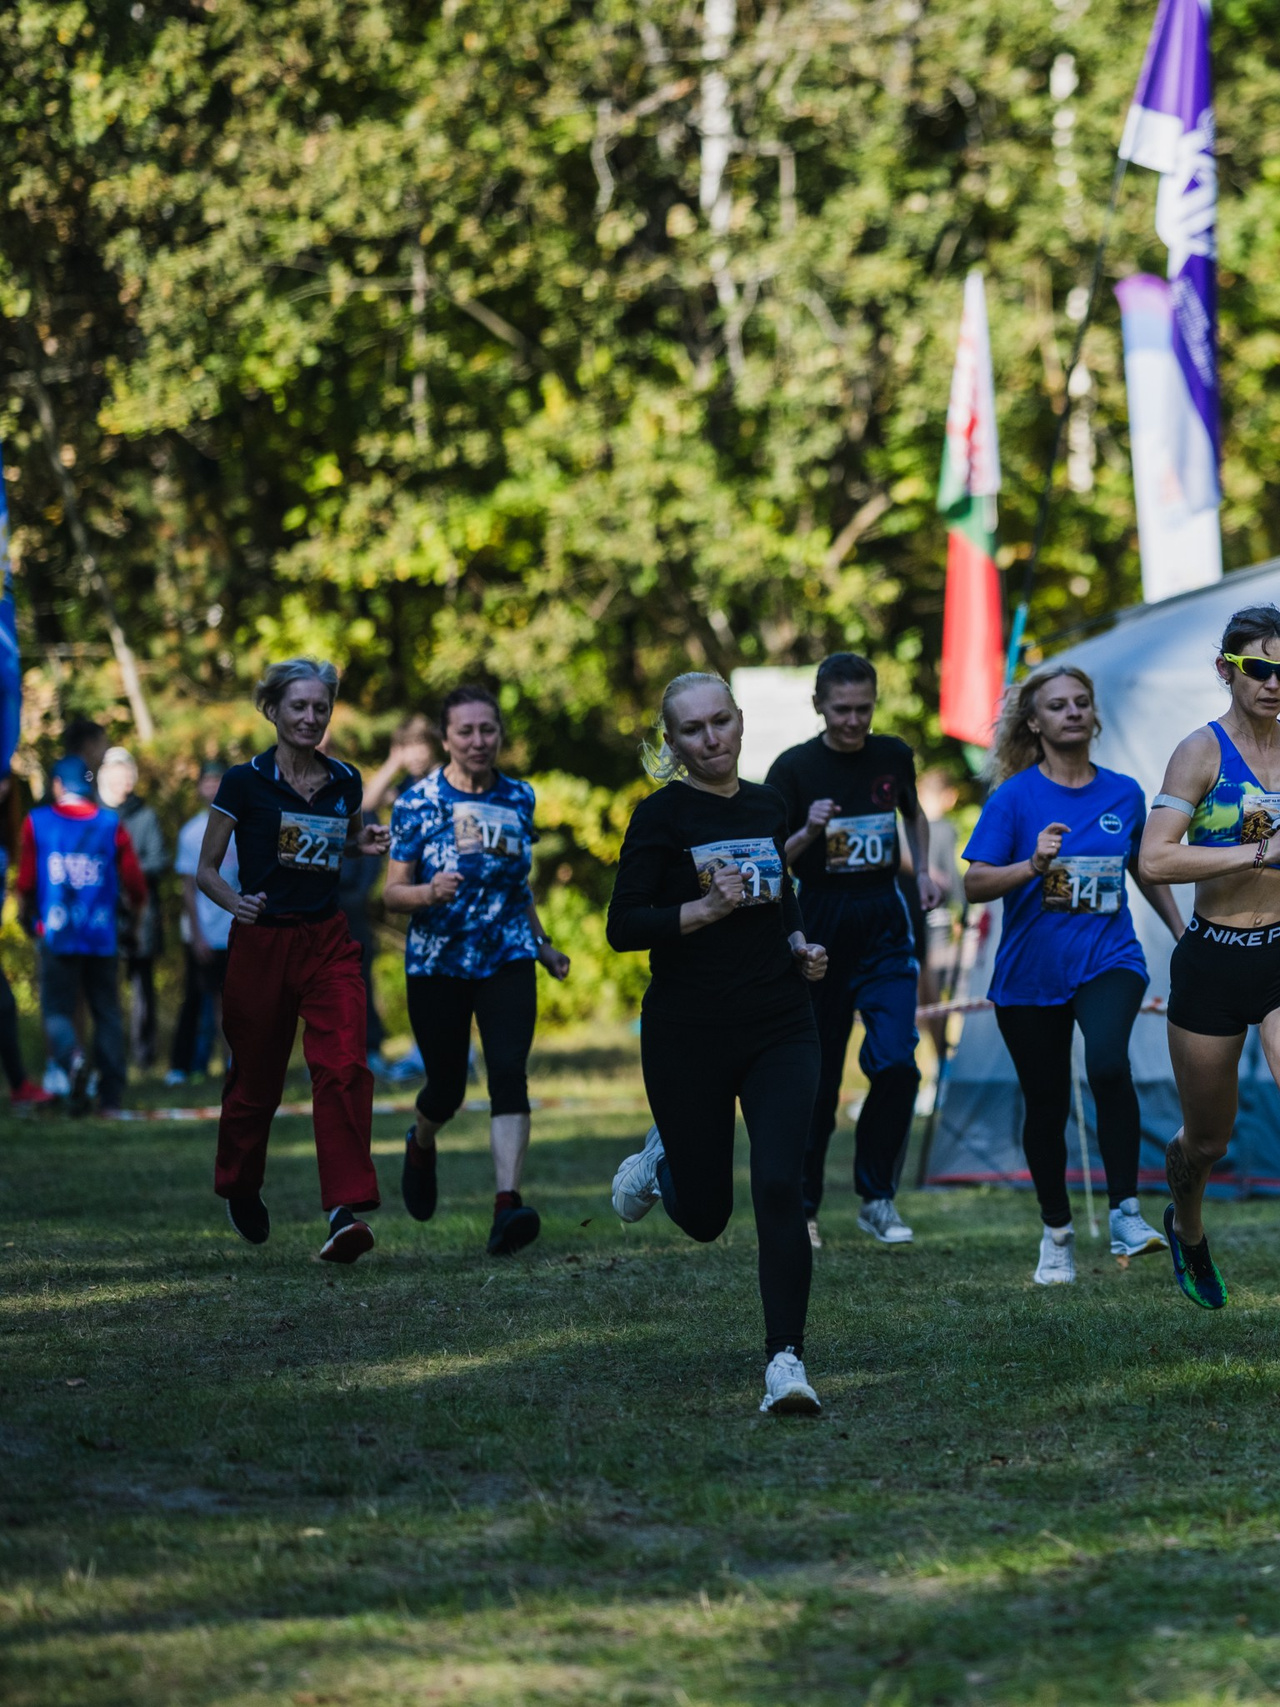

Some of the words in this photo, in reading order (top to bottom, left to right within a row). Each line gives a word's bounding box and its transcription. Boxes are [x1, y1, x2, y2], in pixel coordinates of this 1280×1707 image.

[477, 820, 502, 848] 17
[295, 834, 329, 866] 22
[847, 835, 883, 866] 20
[1068, 876, 1098, 908] 14
[1202, 926, 1265, 947] NIKE
